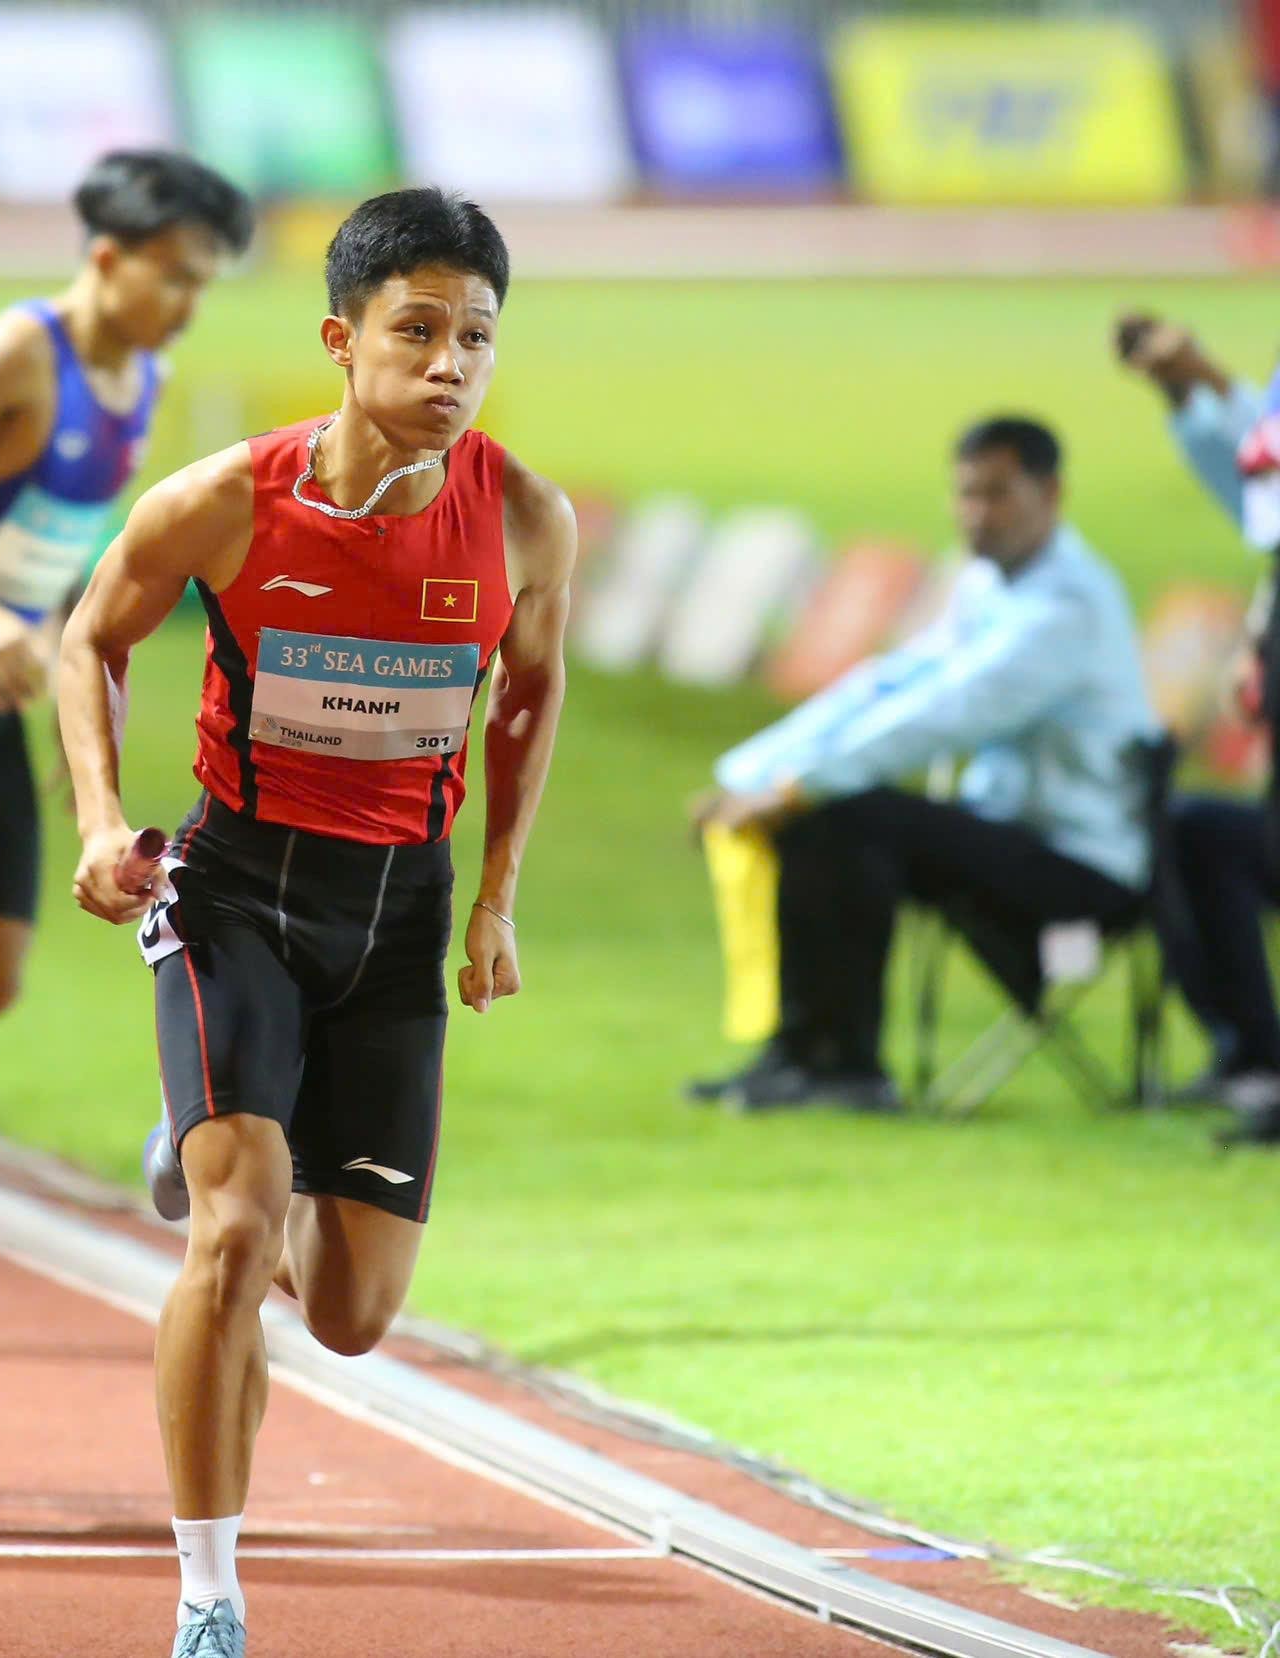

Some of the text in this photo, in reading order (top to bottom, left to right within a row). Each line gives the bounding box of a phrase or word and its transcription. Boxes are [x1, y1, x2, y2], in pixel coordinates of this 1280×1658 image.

[280, 642, 453, 679] 33rd SEA GAMES
[322, 695, 401, 715] KHANH
[279, 726, 450, 748] THAILAND 301
